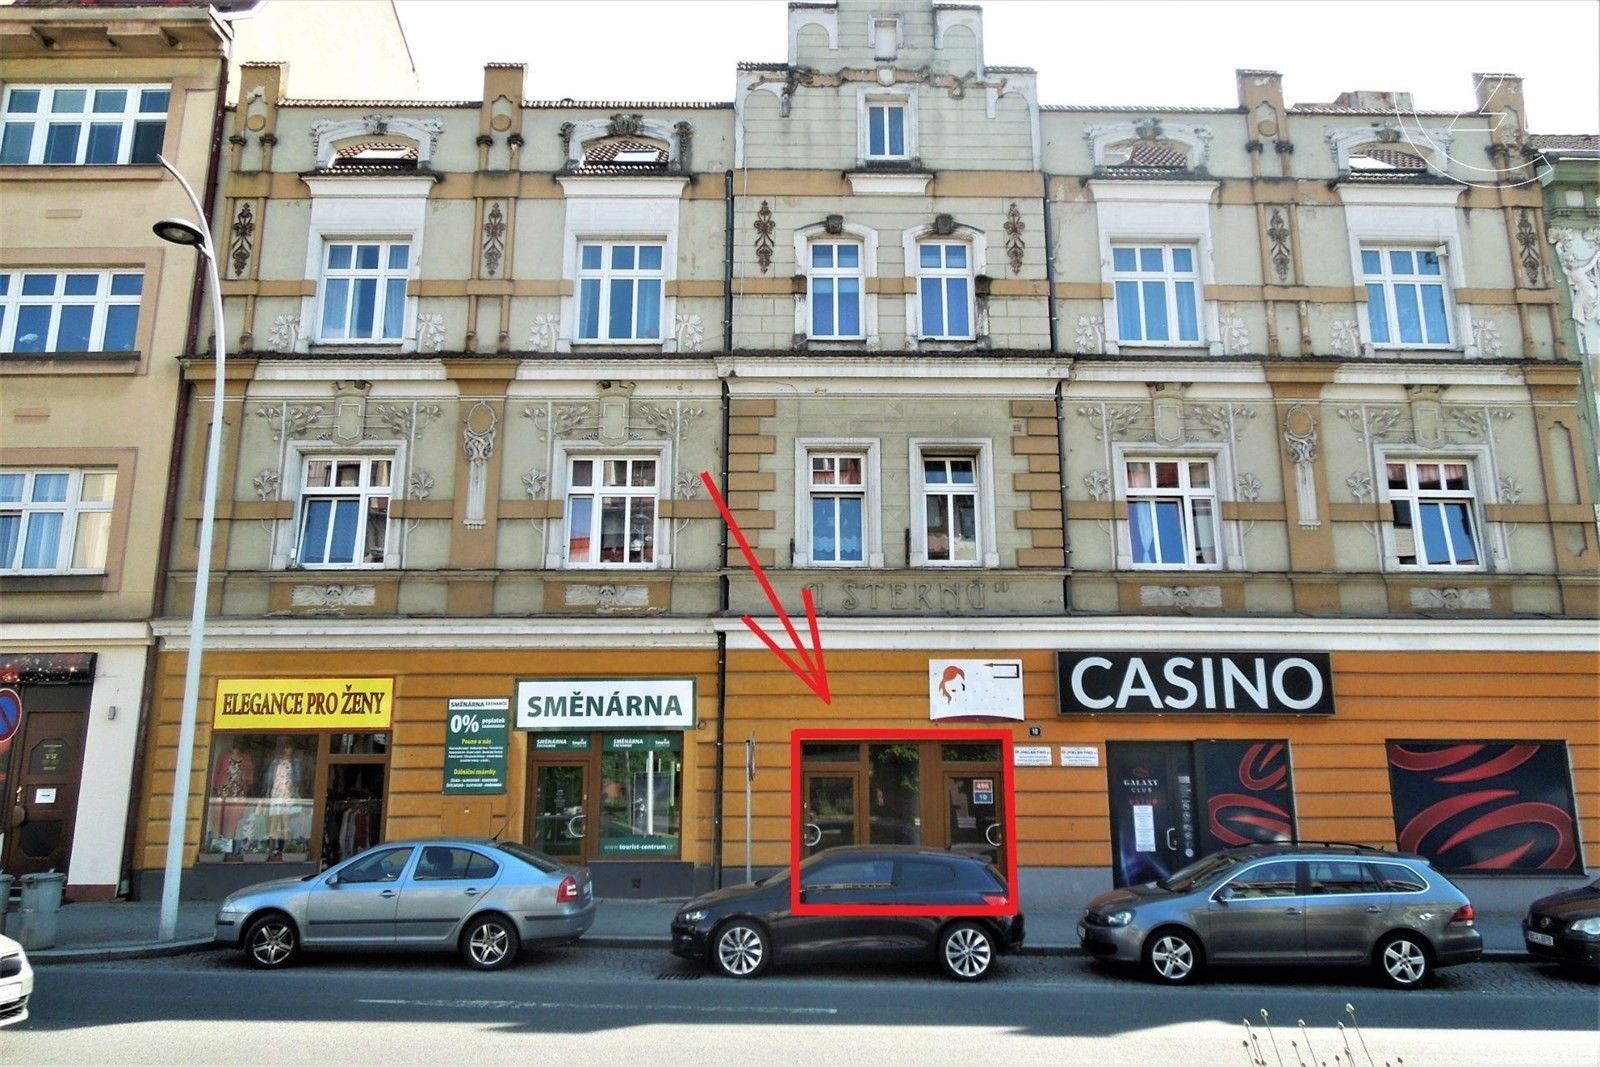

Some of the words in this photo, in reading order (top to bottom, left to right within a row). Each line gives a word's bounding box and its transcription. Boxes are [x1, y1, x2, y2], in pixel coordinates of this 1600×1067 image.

[1071, 656, 1324, 710] CASINO
[221, 692, 304, 716] ELEGANCE
[305, 692, 338, 716] PRO
[341, 684, 385, 715] ŽENY
[450, 700, 485, 708] SMĚNÁRNA
[527, 690, 683, 718] SMĚNÁRNA
[450, 714, 480, 733] 0%
